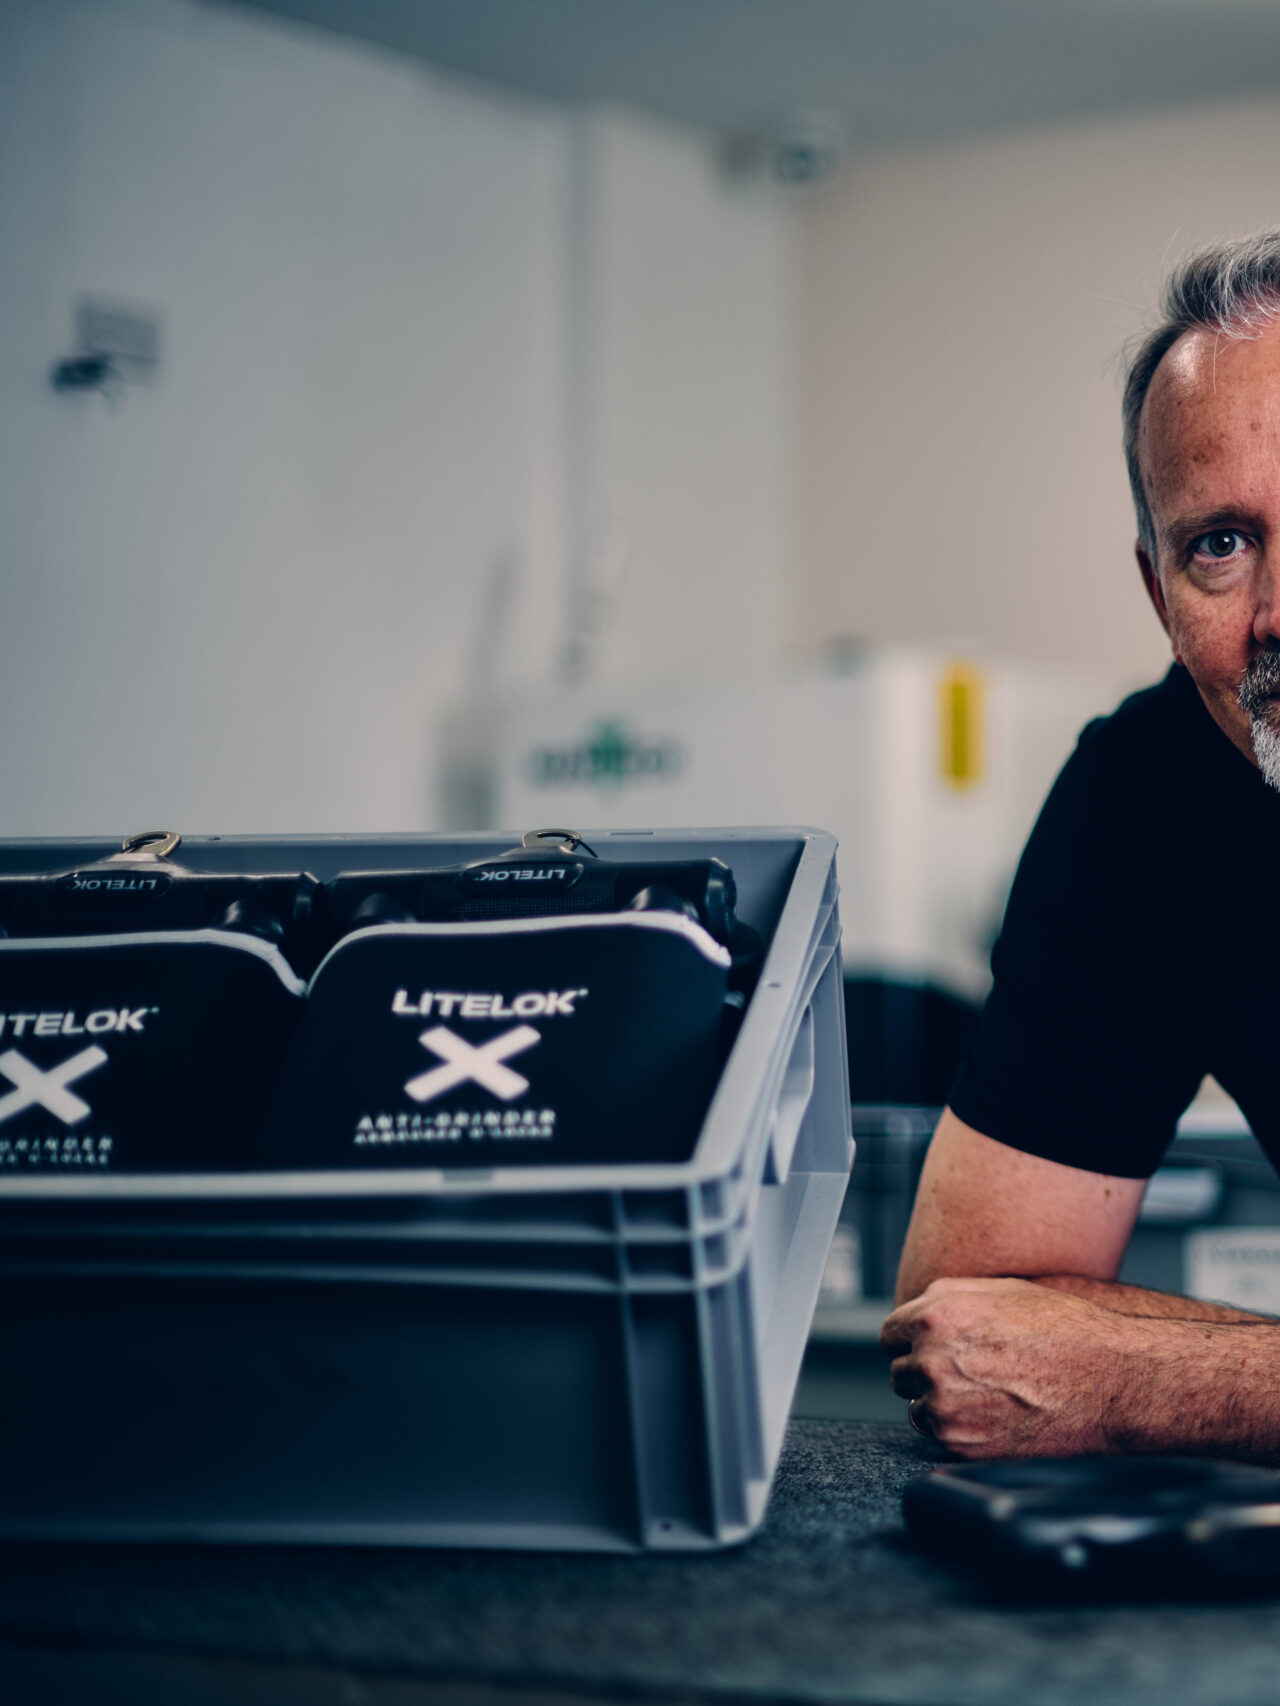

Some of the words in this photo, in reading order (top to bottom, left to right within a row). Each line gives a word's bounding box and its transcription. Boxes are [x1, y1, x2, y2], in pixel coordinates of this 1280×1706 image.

[479, 869, 565, 881] LITELOK
[72, 879, 157, 890] LITELOK
[392, 989, 577, 1017] LITELOK
